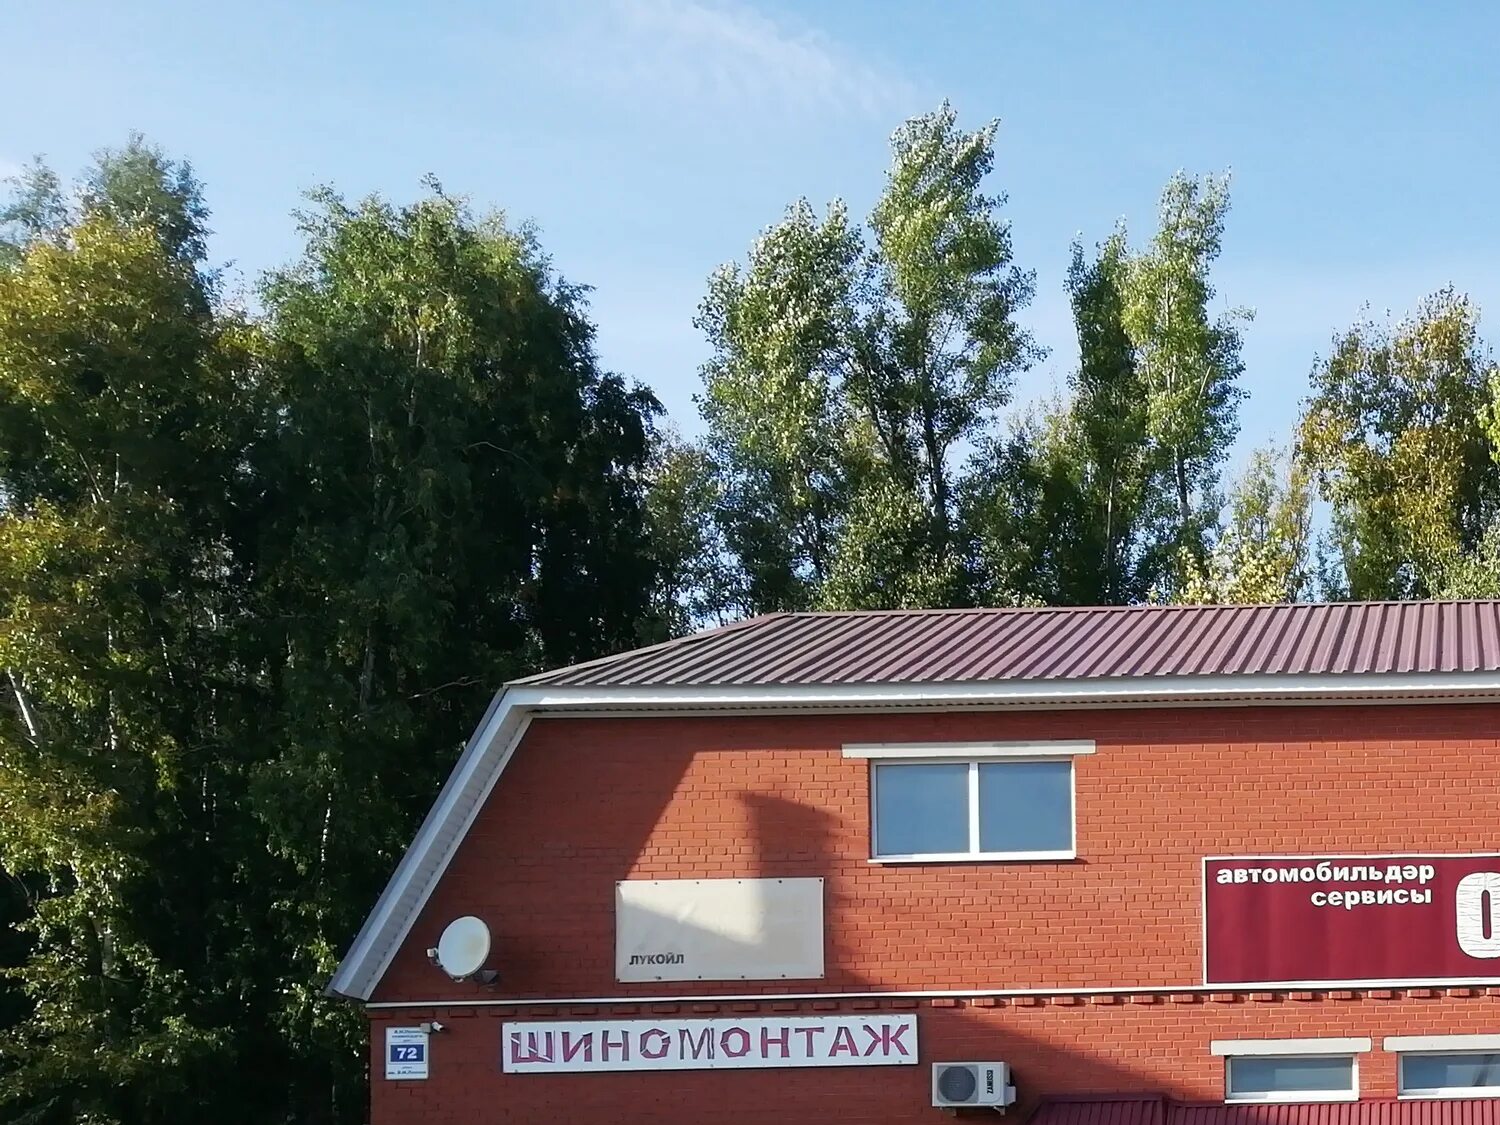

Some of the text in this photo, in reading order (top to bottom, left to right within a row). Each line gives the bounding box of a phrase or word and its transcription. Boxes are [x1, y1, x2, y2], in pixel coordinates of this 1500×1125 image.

[1216, 862, 1435, 884] автомобильдәр
[1310, 886, 1432, 910] сервисы
[629, 952, 684, 965] ЛУКОЙЛ
[397, 1047, 417, 1060] 72
[511, 1023, 910, 1063] ШИНОМОНТАЖ
